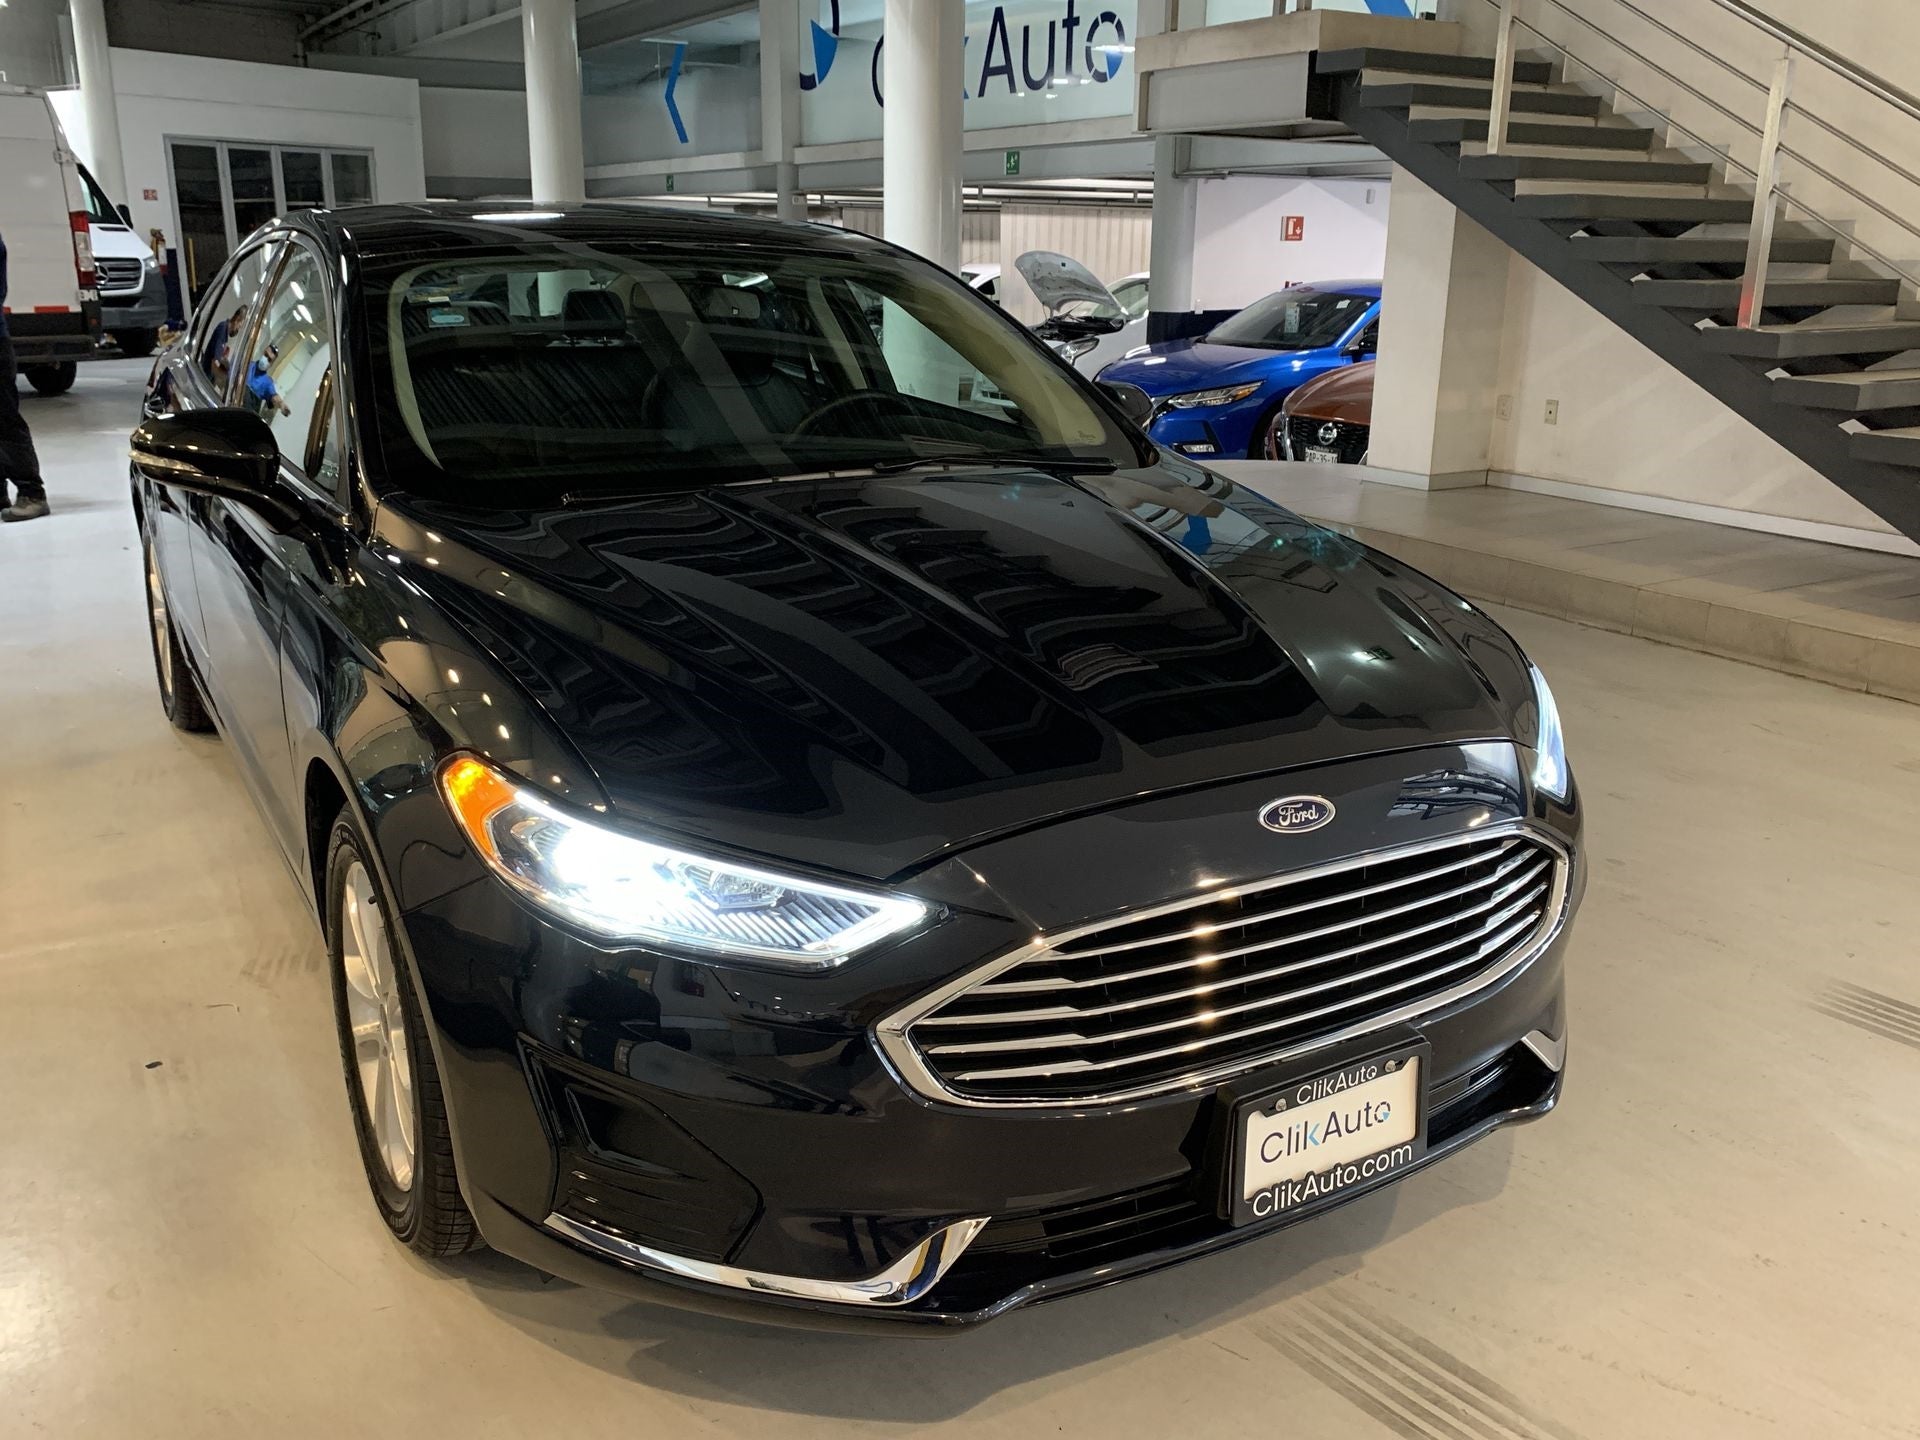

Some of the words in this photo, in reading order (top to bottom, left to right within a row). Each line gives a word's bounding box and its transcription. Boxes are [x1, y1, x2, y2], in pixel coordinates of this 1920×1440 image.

[1278, 803, 1319, 826] Ford
[1296, 1065, 1378, 1105] ClikAuto
[1260, 1101, 1391, 1163] ClikAuto
[1252, 1144, 1412, 1217] ClikAuto.com
